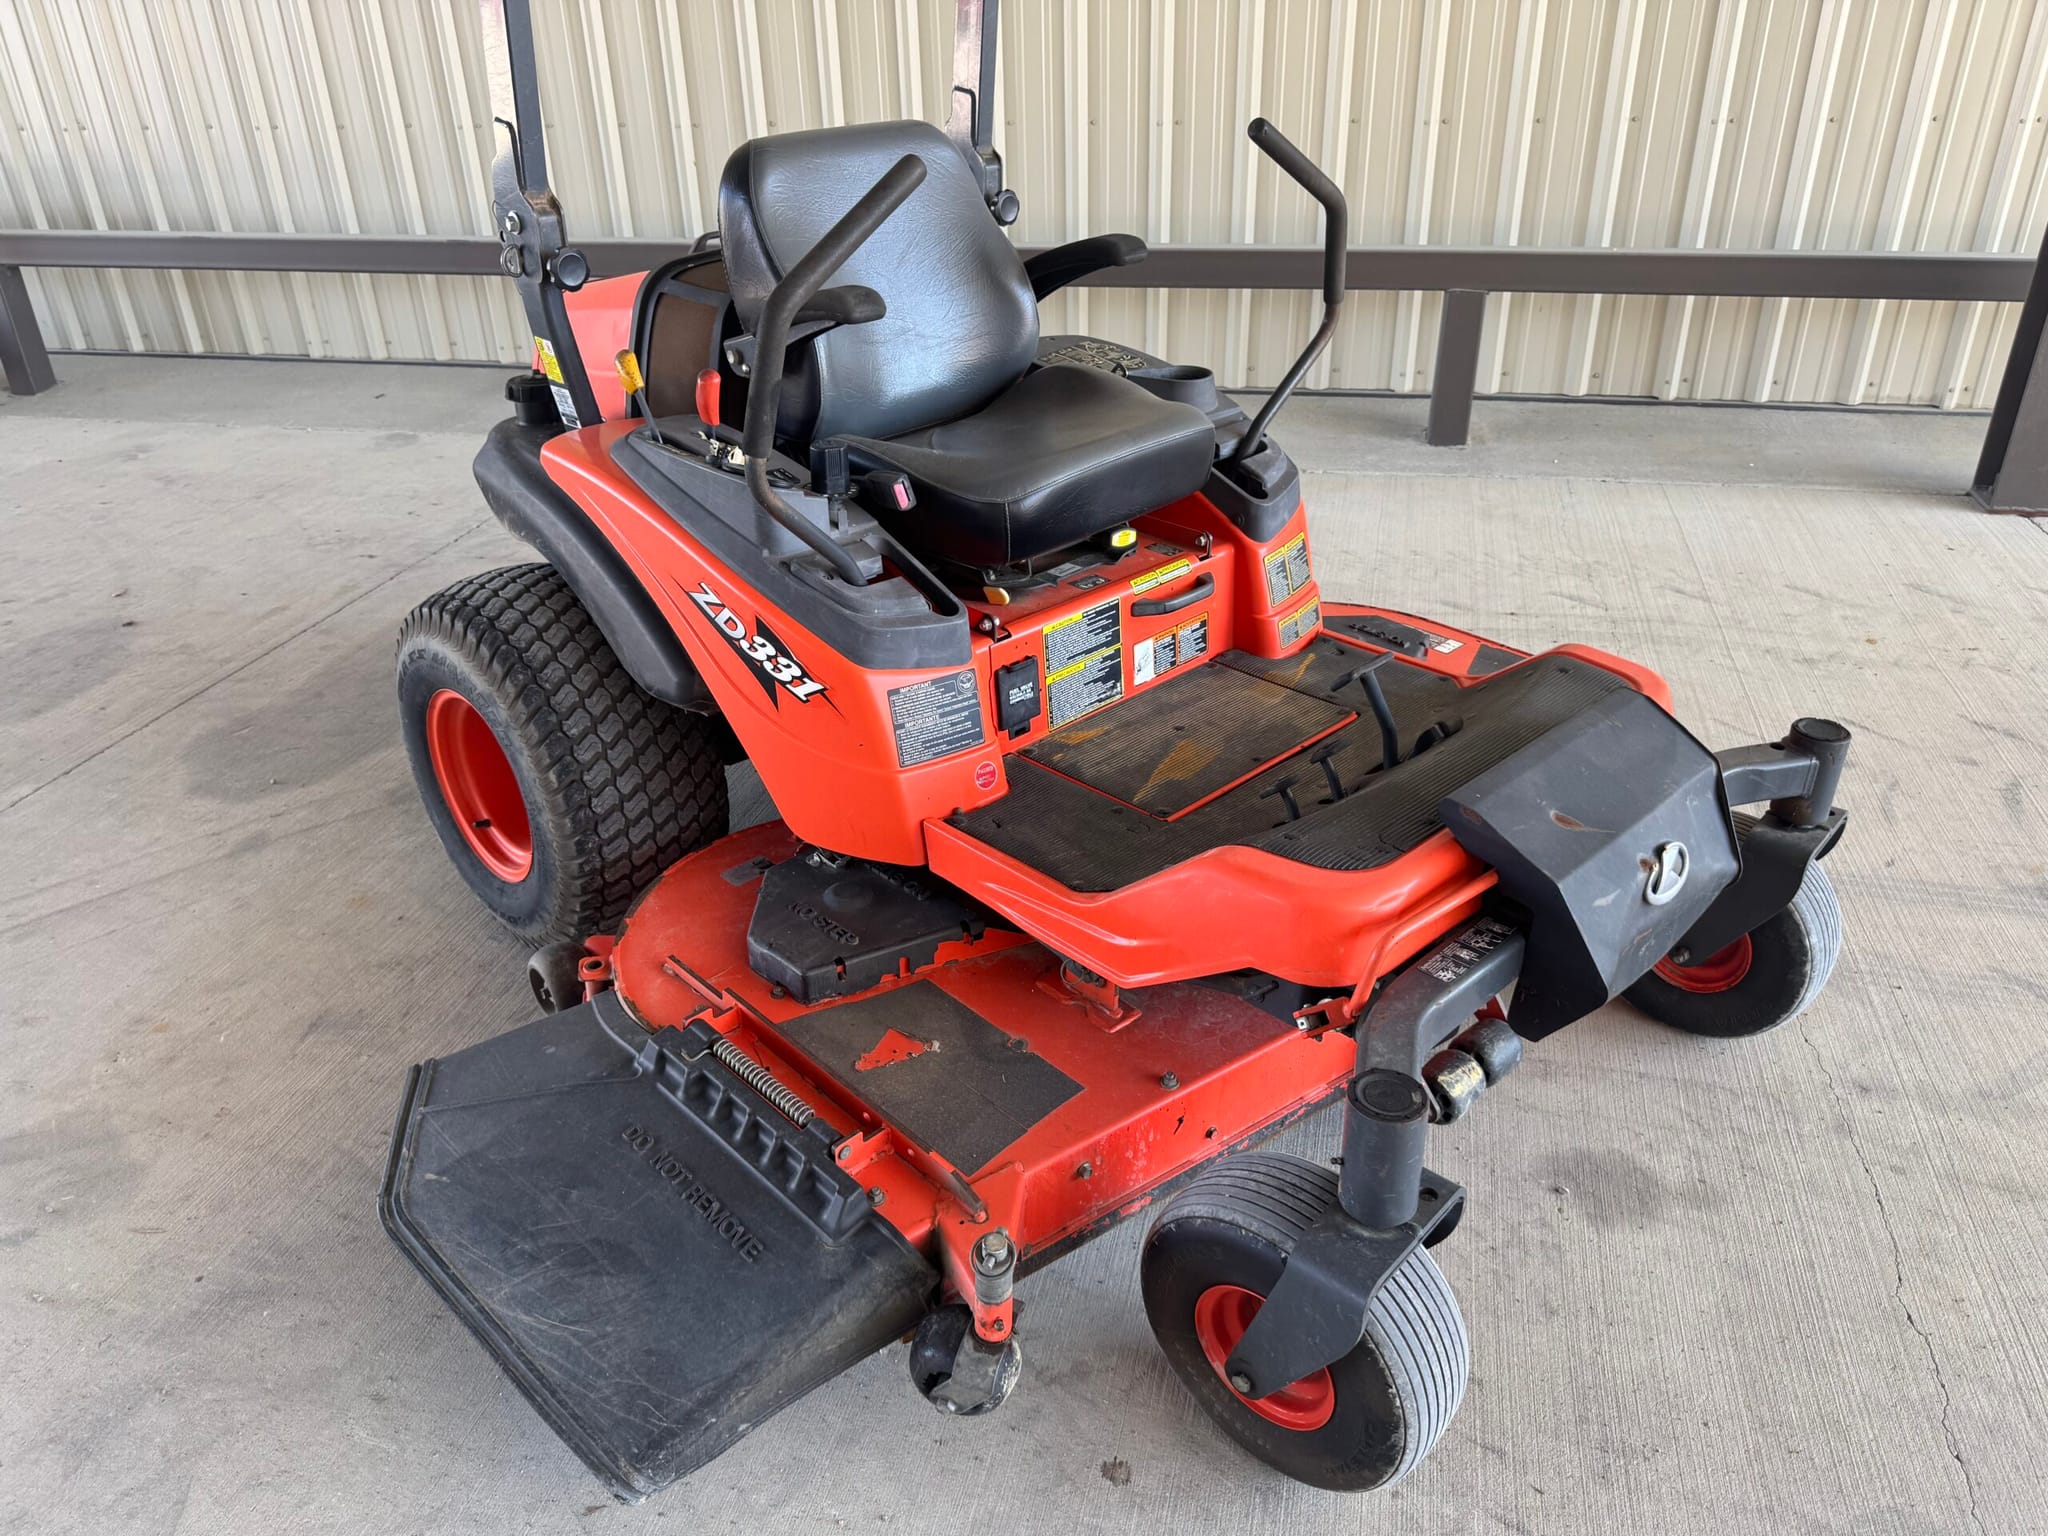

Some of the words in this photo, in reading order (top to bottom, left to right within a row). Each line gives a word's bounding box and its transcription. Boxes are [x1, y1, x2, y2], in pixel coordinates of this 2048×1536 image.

[687, 581, 826, 702] ZD331
[899, 681, 932, 693] IMPORTANT
[904, 715, 940, 728] IMPORTANTE
[789, 902, 817, 920] NO
[814, 915, 860, 946] STEP
[622, 1125, 655, 1153] DO
[649, 1151, 693, 1185] NOT
[681, 1184, 764, 1263] REMOVE
